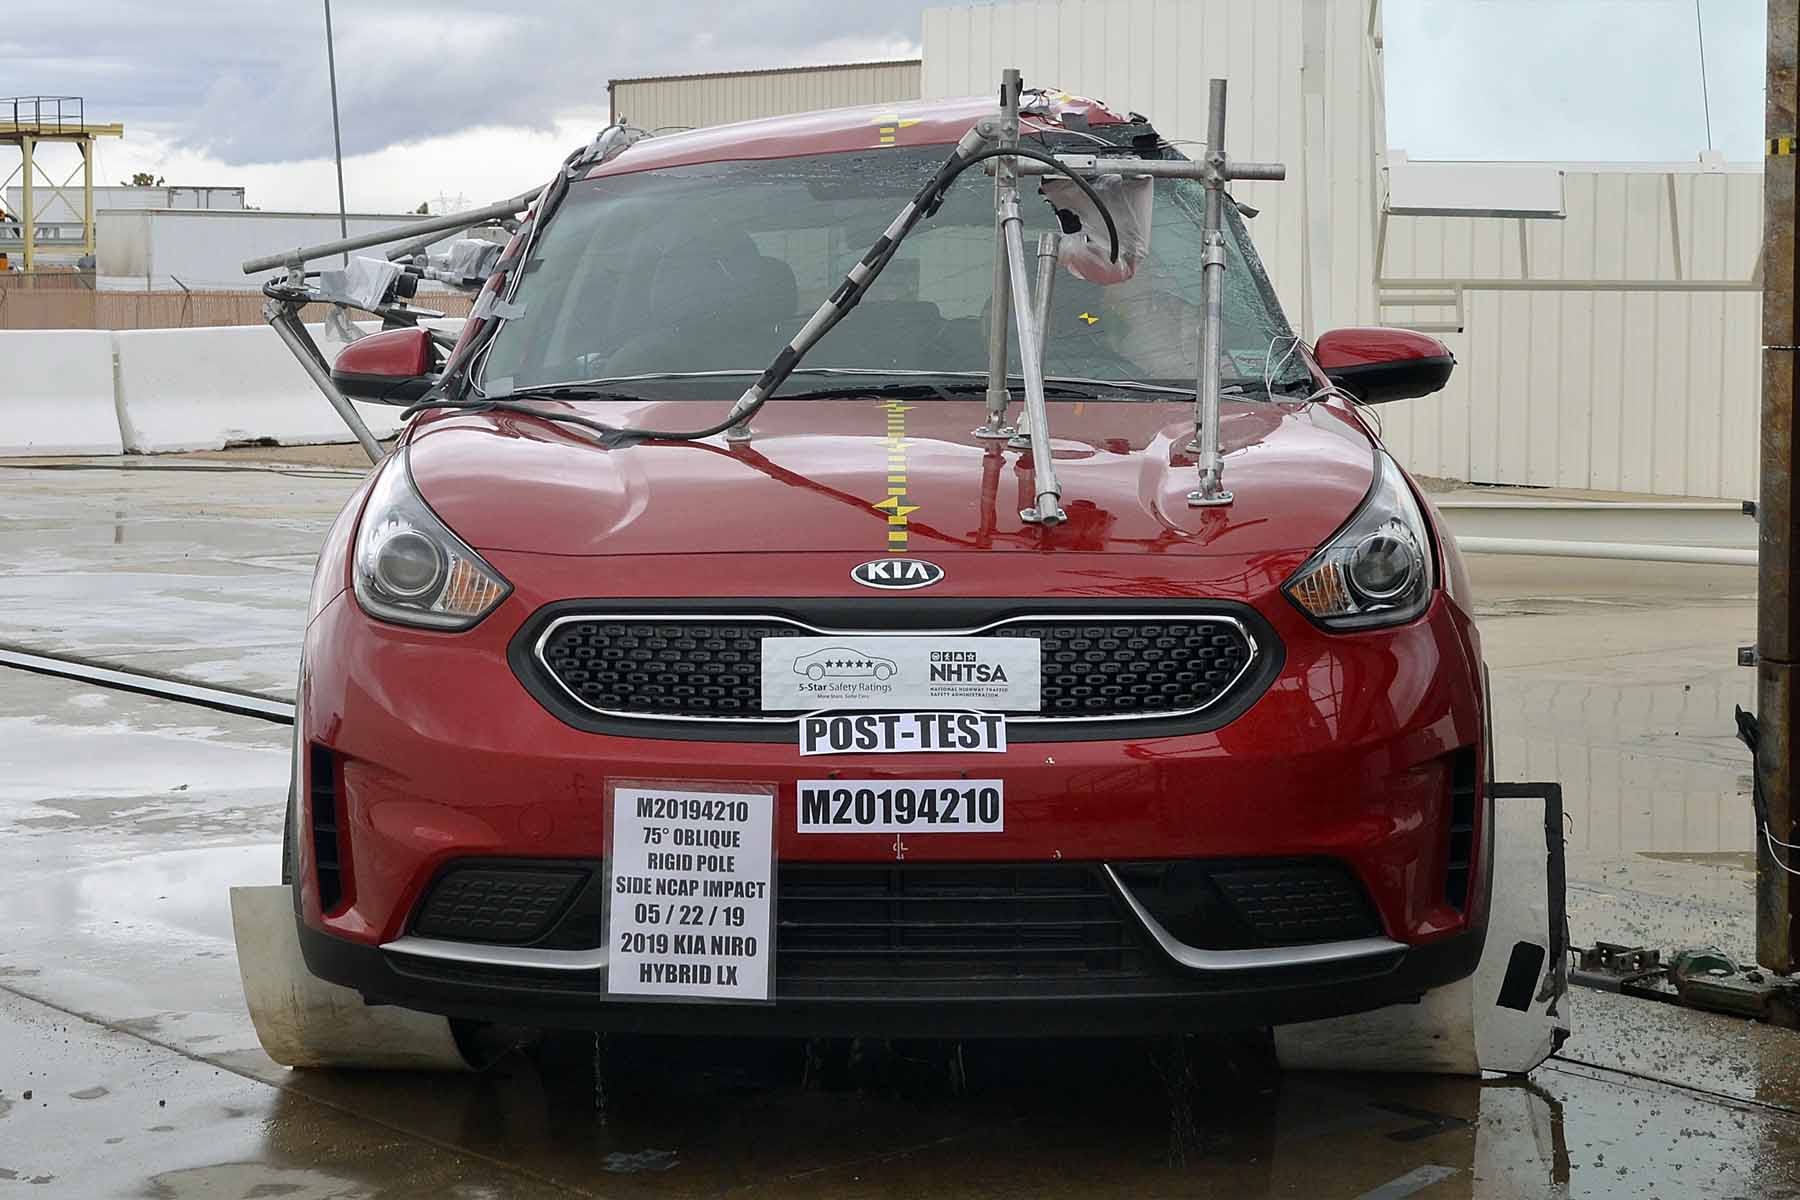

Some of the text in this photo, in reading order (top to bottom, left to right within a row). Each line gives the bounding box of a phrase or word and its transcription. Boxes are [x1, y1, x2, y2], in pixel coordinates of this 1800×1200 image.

[868, 562, 929, 580] KIA
[930, 664, 1008, 682] NHTSA
[799, 682, 892, 694] 5-Star Safety Ratings
[806, 714, 1000, 752] POST-TEST
[636, 798, 748, 822] M20194210
[802, 788, 999, 824] M20194210
[643, 827, 741, 848] 75° OBLIQUE
[647, 853, 735, 873] RIGID POLE
[616, 876, 766, 899] SIDE NCAP IMPACT
[620, 932, 757, 957] 2019 KIA NIRO
[639, 963, 738, 986] HYBRID LX
